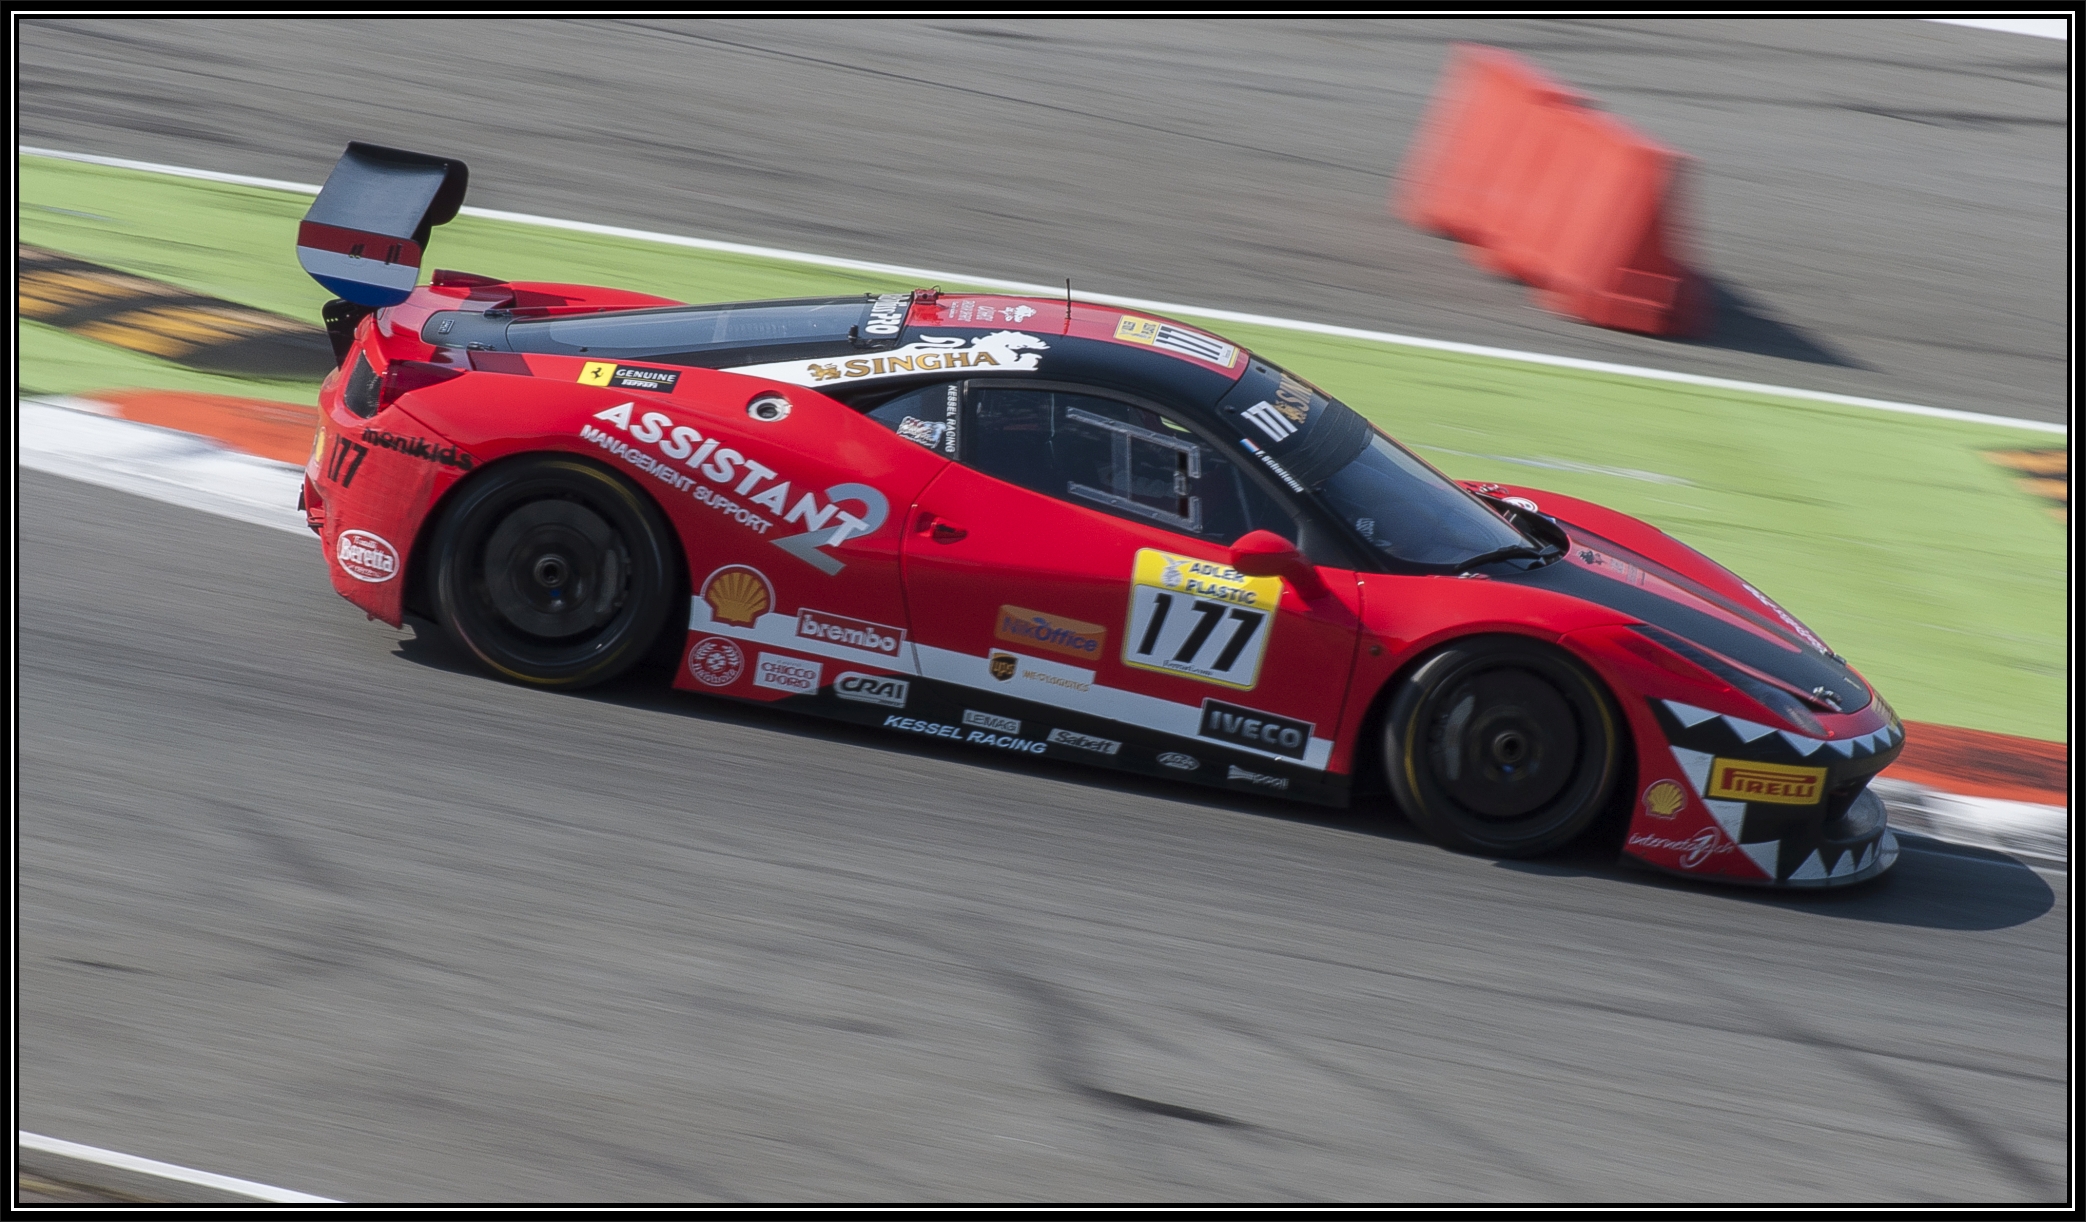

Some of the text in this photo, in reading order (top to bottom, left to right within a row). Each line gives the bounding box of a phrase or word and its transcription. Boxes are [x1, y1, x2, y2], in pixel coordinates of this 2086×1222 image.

[616, 369, 676, 383] GENUINE
[844, 351, 1001, 378] SINGHA
[945, 385, 957, 453] KESSEL RACING
[1240, 401, 1298, 442] 177
[580, 424, 773, 534] MANAGEMENT SUPPORT
[593, 402, 870, 547] ASSISTANT
[340, 537, 394, 573] Beretta
[1189, 563, 1246, 583] ADLER
[1185, 579, 1257, 604] PLASTIC
[801, 614, 897, 651] brembo
[1137, 592, 1265, 672] 177
[761, 661, 817, 680] CHICCO
[842, 676, 901, 700] CRAI
[883, 715, 1048, 754] KESSEL RACING
[965, 713, 1017, 731] LEMAG
[1209, 710, 1303, 748] IVECO
[1720, 767, 1817, 798] PIRELLI
